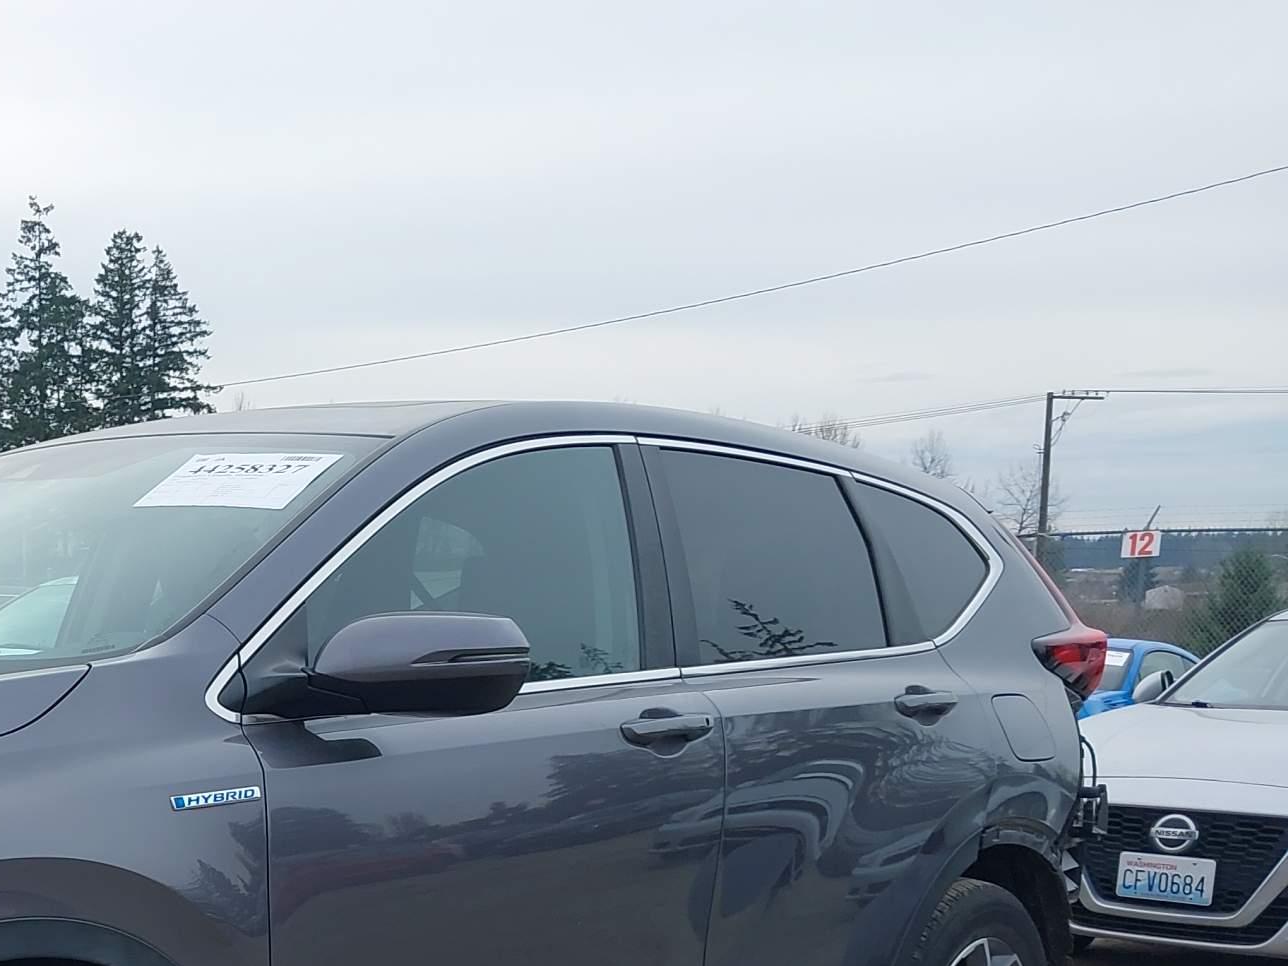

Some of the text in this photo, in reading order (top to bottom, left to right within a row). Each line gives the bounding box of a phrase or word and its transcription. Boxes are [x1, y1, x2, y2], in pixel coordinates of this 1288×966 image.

[188, 464, 309, 474] 44258327
[1129, 533, 1154, 556] 12
[187, 789, 255, 805] HYBRID
[1154, 829, 1194, 838] NISSAN
[1127, 861, 1177, 871] WASHINGTON
[1122, 868, 1205, 897] CFV0684
